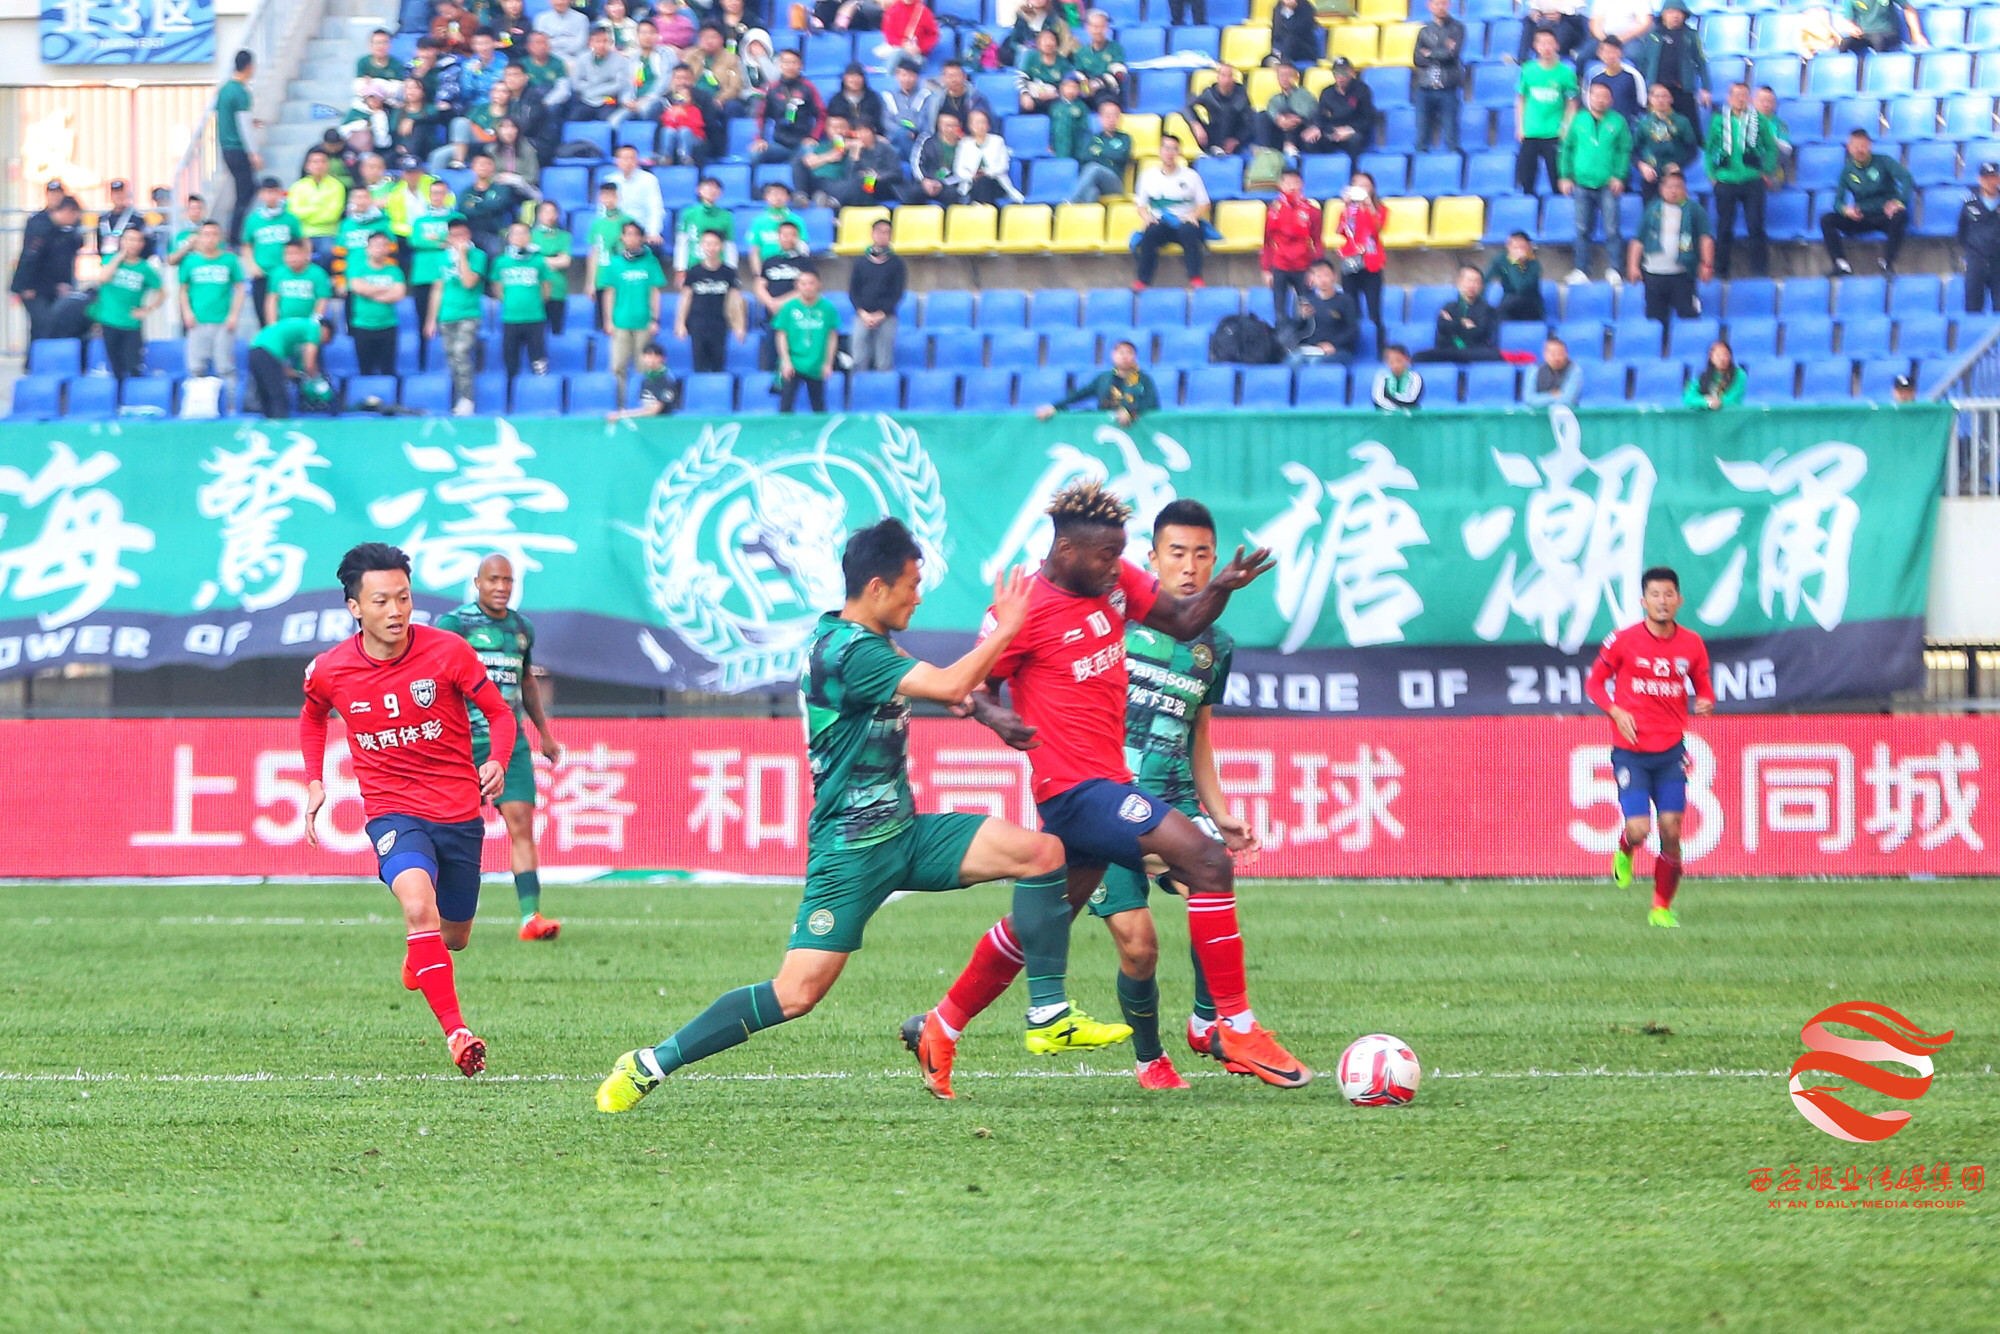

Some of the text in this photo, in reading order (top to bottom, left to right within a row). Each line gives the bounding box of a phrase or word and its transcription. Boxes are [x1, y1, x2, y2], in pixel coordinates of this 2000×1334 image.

[53, 0, 195, 33] 北3区
[184, 621, 252, 656] OF
[1086, 610, 1112, 638] 10
[1125, 657, 1206, 697] Panasonic
[1400, 669, 1468, 710] OF
[384, 693, 400, 719] 9
[355, 719, 444, 751] 陕西体彩
